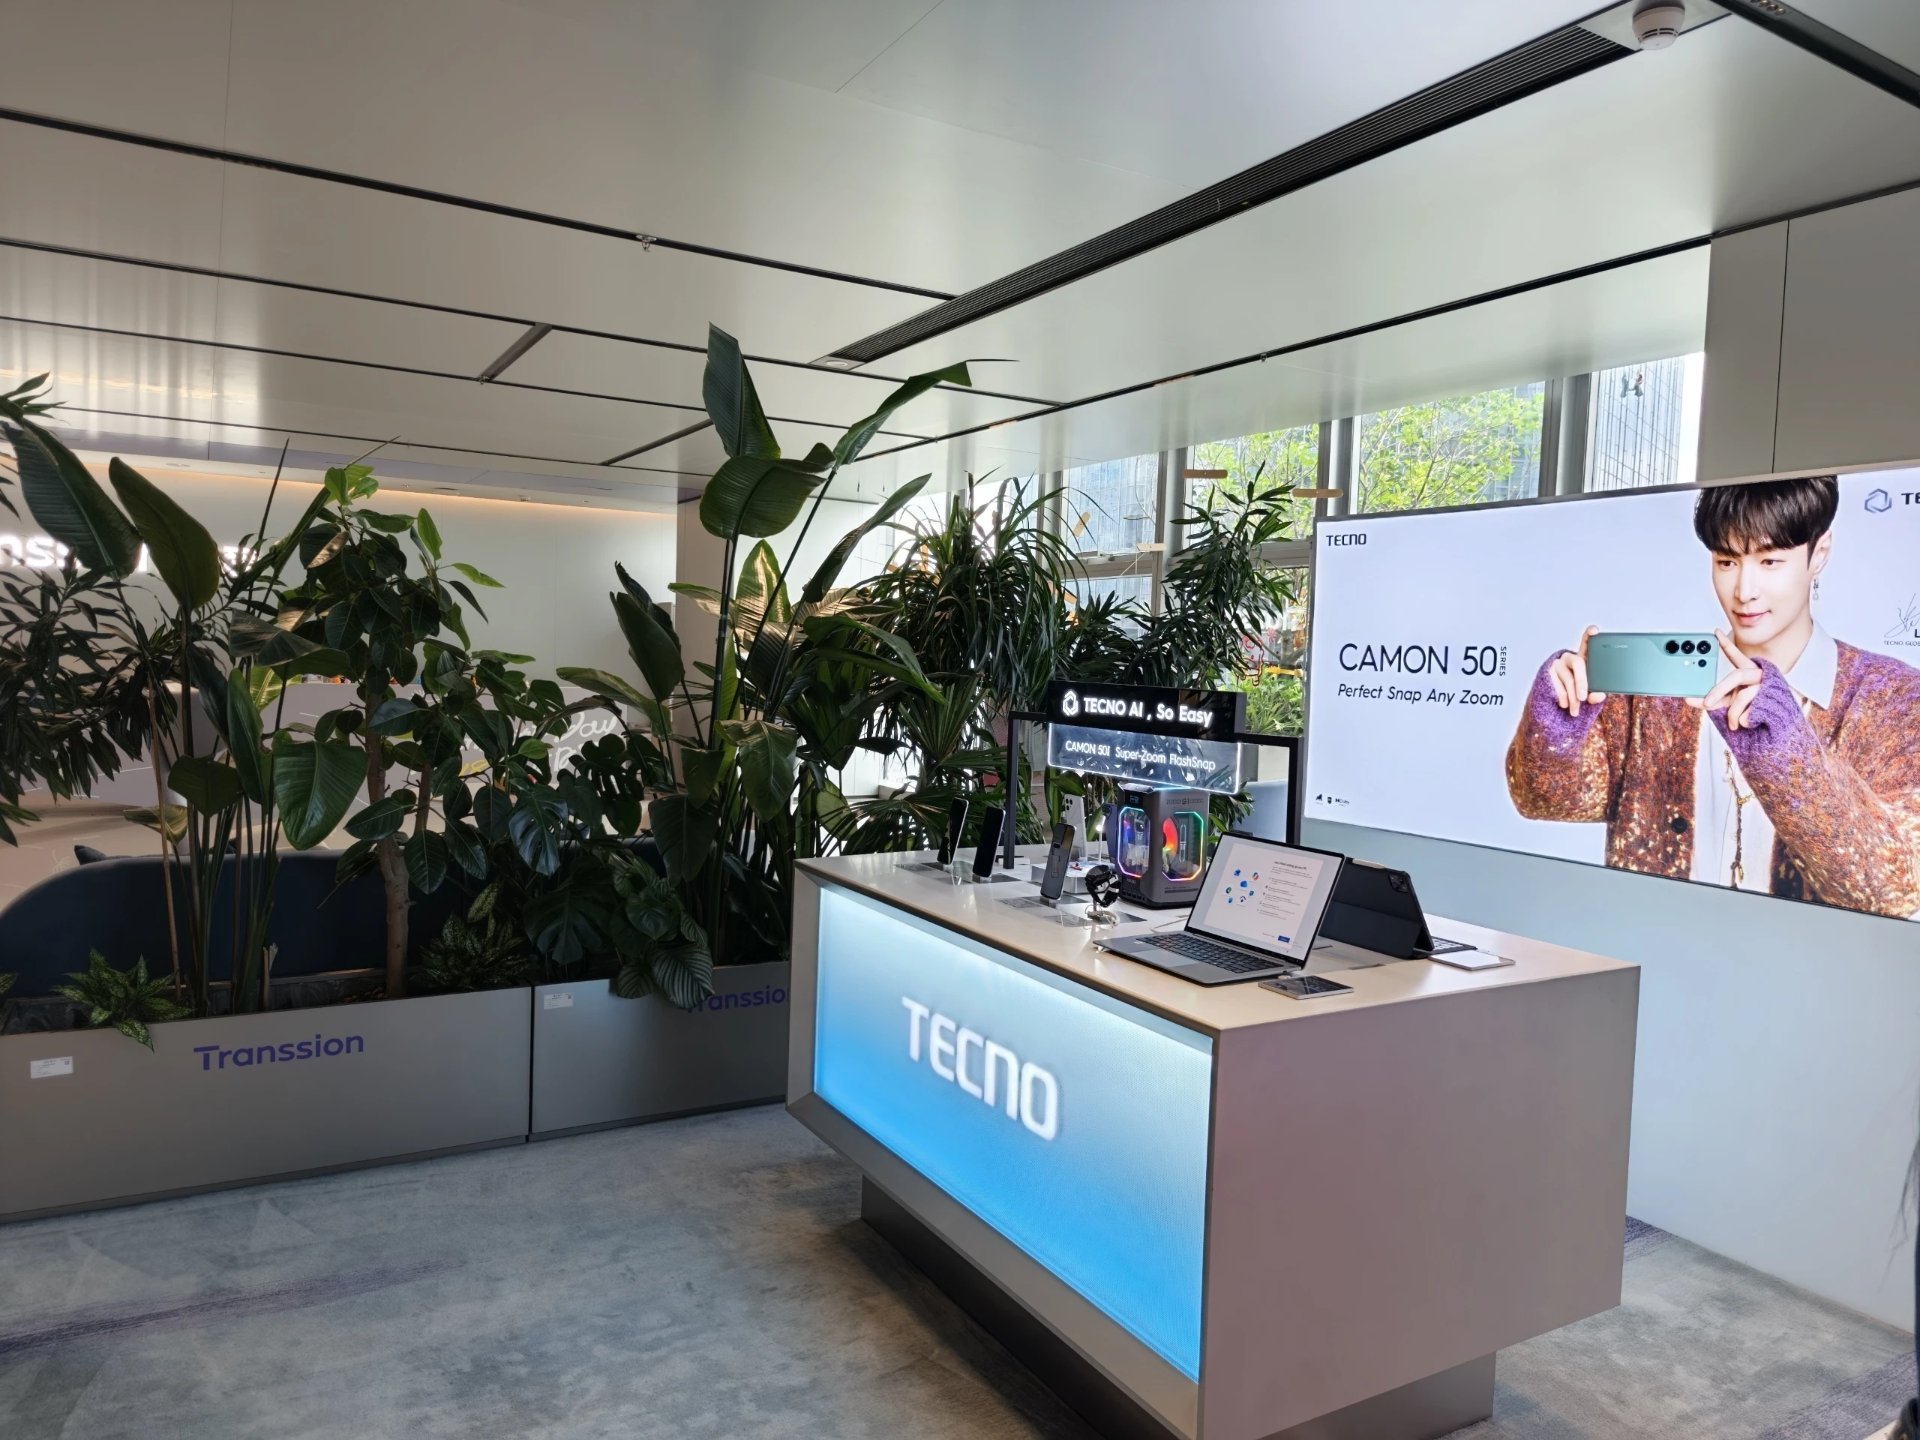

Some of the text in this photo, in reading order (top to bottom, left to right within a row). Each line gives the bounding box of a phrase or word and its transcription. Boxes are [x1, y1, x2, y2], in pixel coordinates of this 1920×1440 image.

[1326, 533, 1367, 547] TECNO
[1339, 642, 1498, 677] CAMON 50
[1499, 646, 1507, 677] SERIES
[1337, 683, 1504, 707] Perfect Snap Any Zoom
[1083, 697, 1126, 716] TECNO
[1156, 703, 1174, 720] So
[1178, 705, 1213, 728] Easy
[1065, 740, 1096, 755] CAMON
[1115, 746, 1166, 764] Super-Zoom
[1169, 753, 1216, 772] FlashSnap
[193, 1034, 364, 1071] Transsion
[901, 995, 1058, 1141] TECNO
